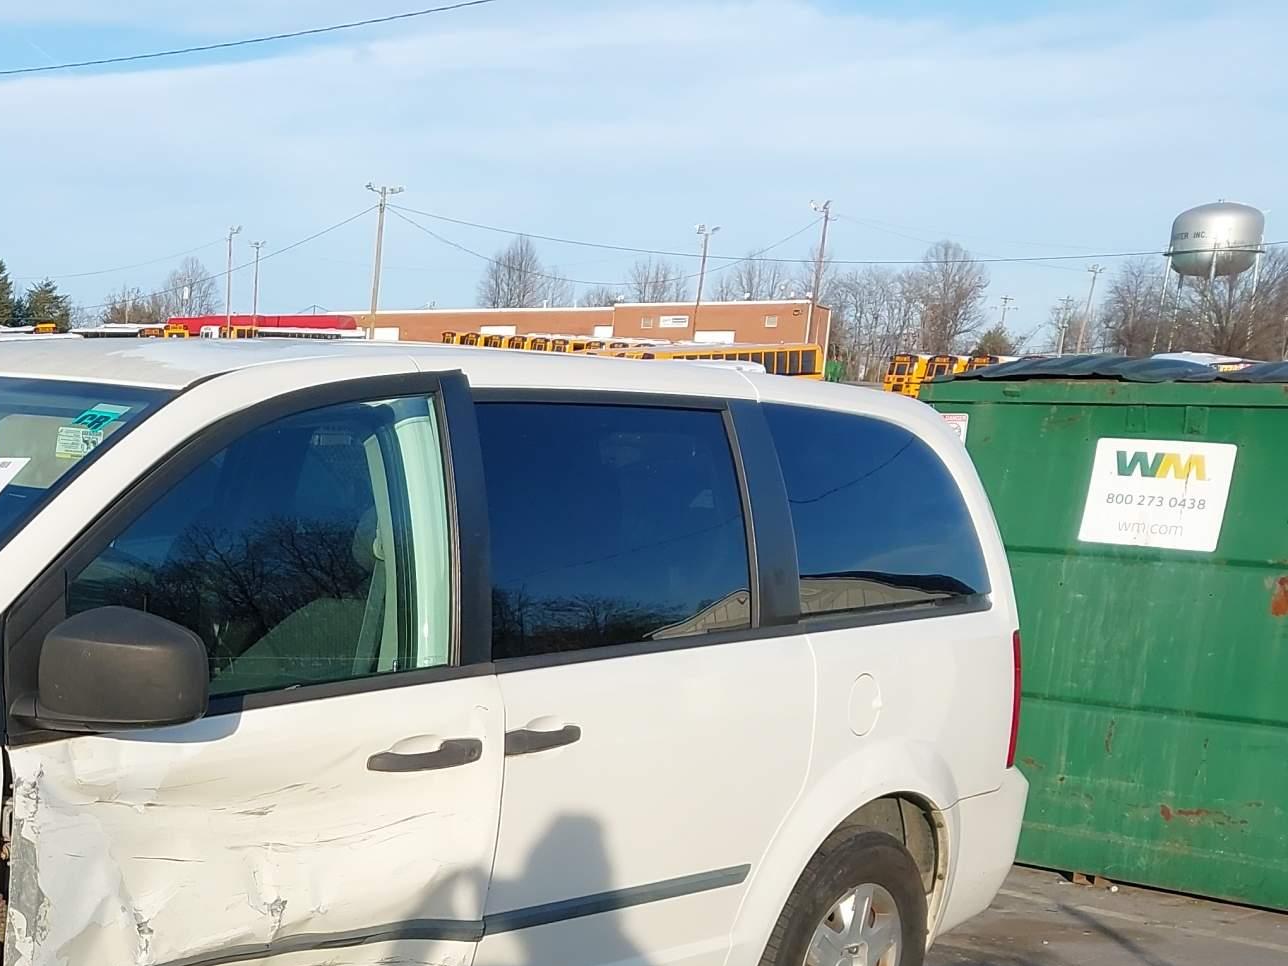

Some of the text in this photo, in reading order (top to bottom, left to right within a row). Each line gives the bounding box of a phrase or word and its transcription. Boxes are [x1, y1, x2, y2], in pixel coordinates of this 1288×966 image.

[1116, 450, 1206, 481] WM
[1106, 493, 1206, 510] 800 273 0438
[1117, 520, 1184, 537] wm.com
